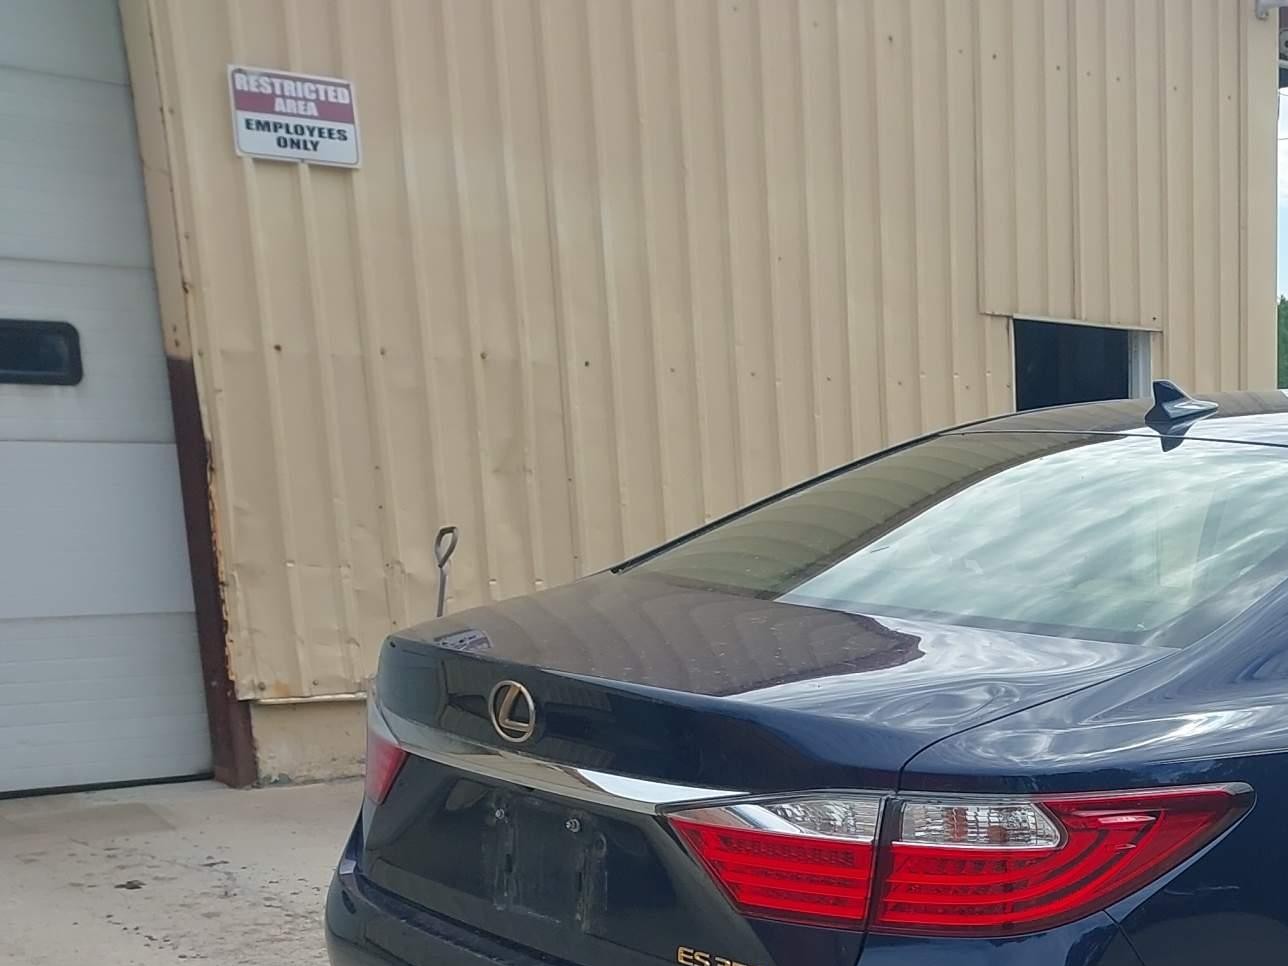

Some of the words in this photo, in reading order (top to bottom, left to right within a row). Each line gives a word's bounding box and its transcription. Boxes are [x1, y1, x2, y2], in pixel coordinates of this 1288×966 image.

[234, 73, 350, 104] RESTRICTED
[274, 97, 318, 116] AREA
[244, 118, 348, 141] EMPLOYEES
[276, 136, 319, 151] ONLY
